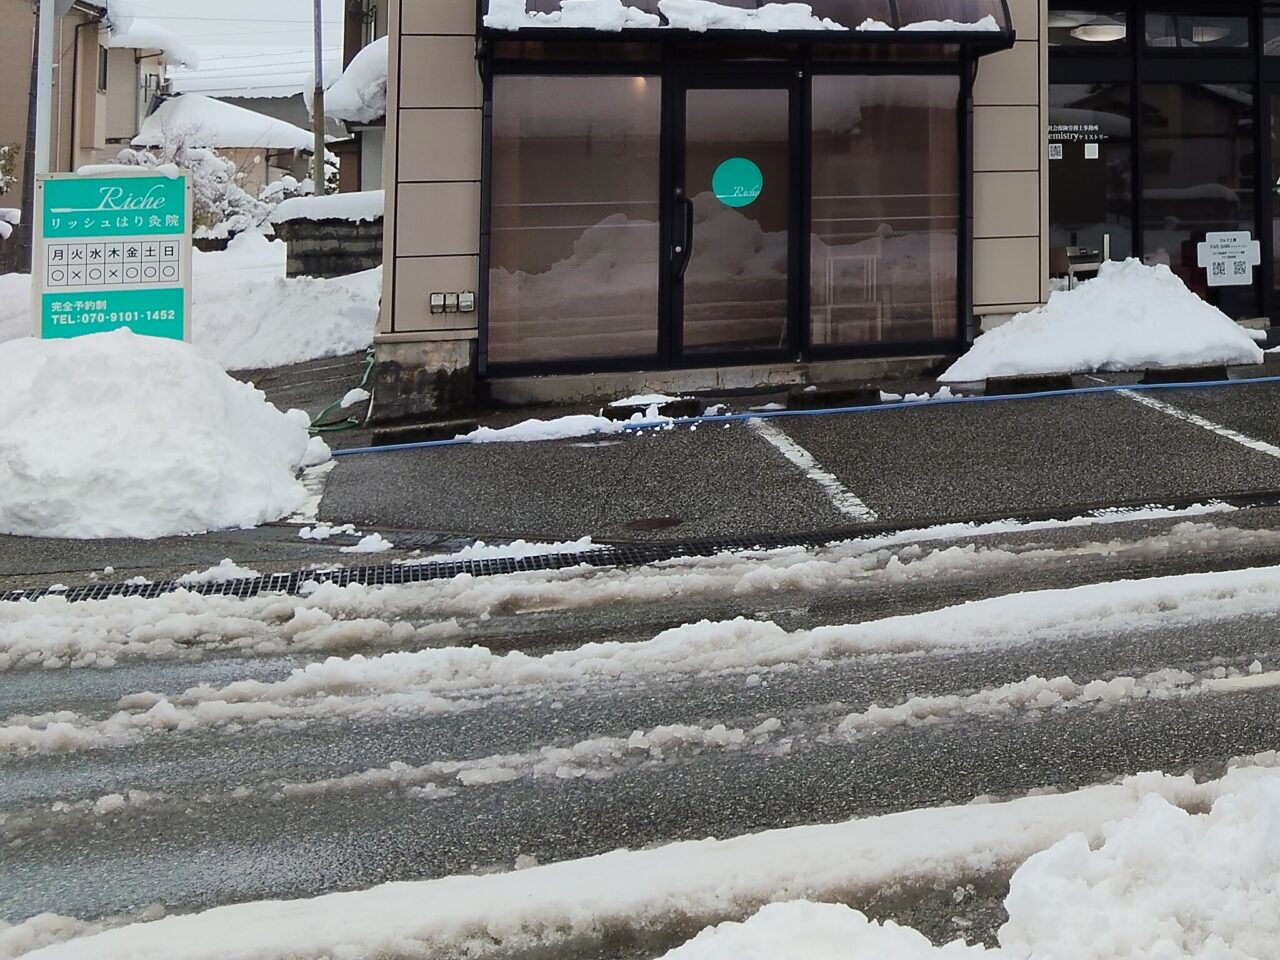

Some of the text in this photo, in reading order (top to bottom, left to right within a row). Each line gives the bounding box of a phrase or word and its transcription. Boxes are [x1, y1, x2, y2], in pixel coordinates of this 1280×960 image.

[97, 184, 166, 211] Riche
[51, 214, 180, 229] リッシュはり灸院
[52, 246, 174, 261] 月 火 水 木 金 土 日
[51, 300, 107, 312] 完全予約制
